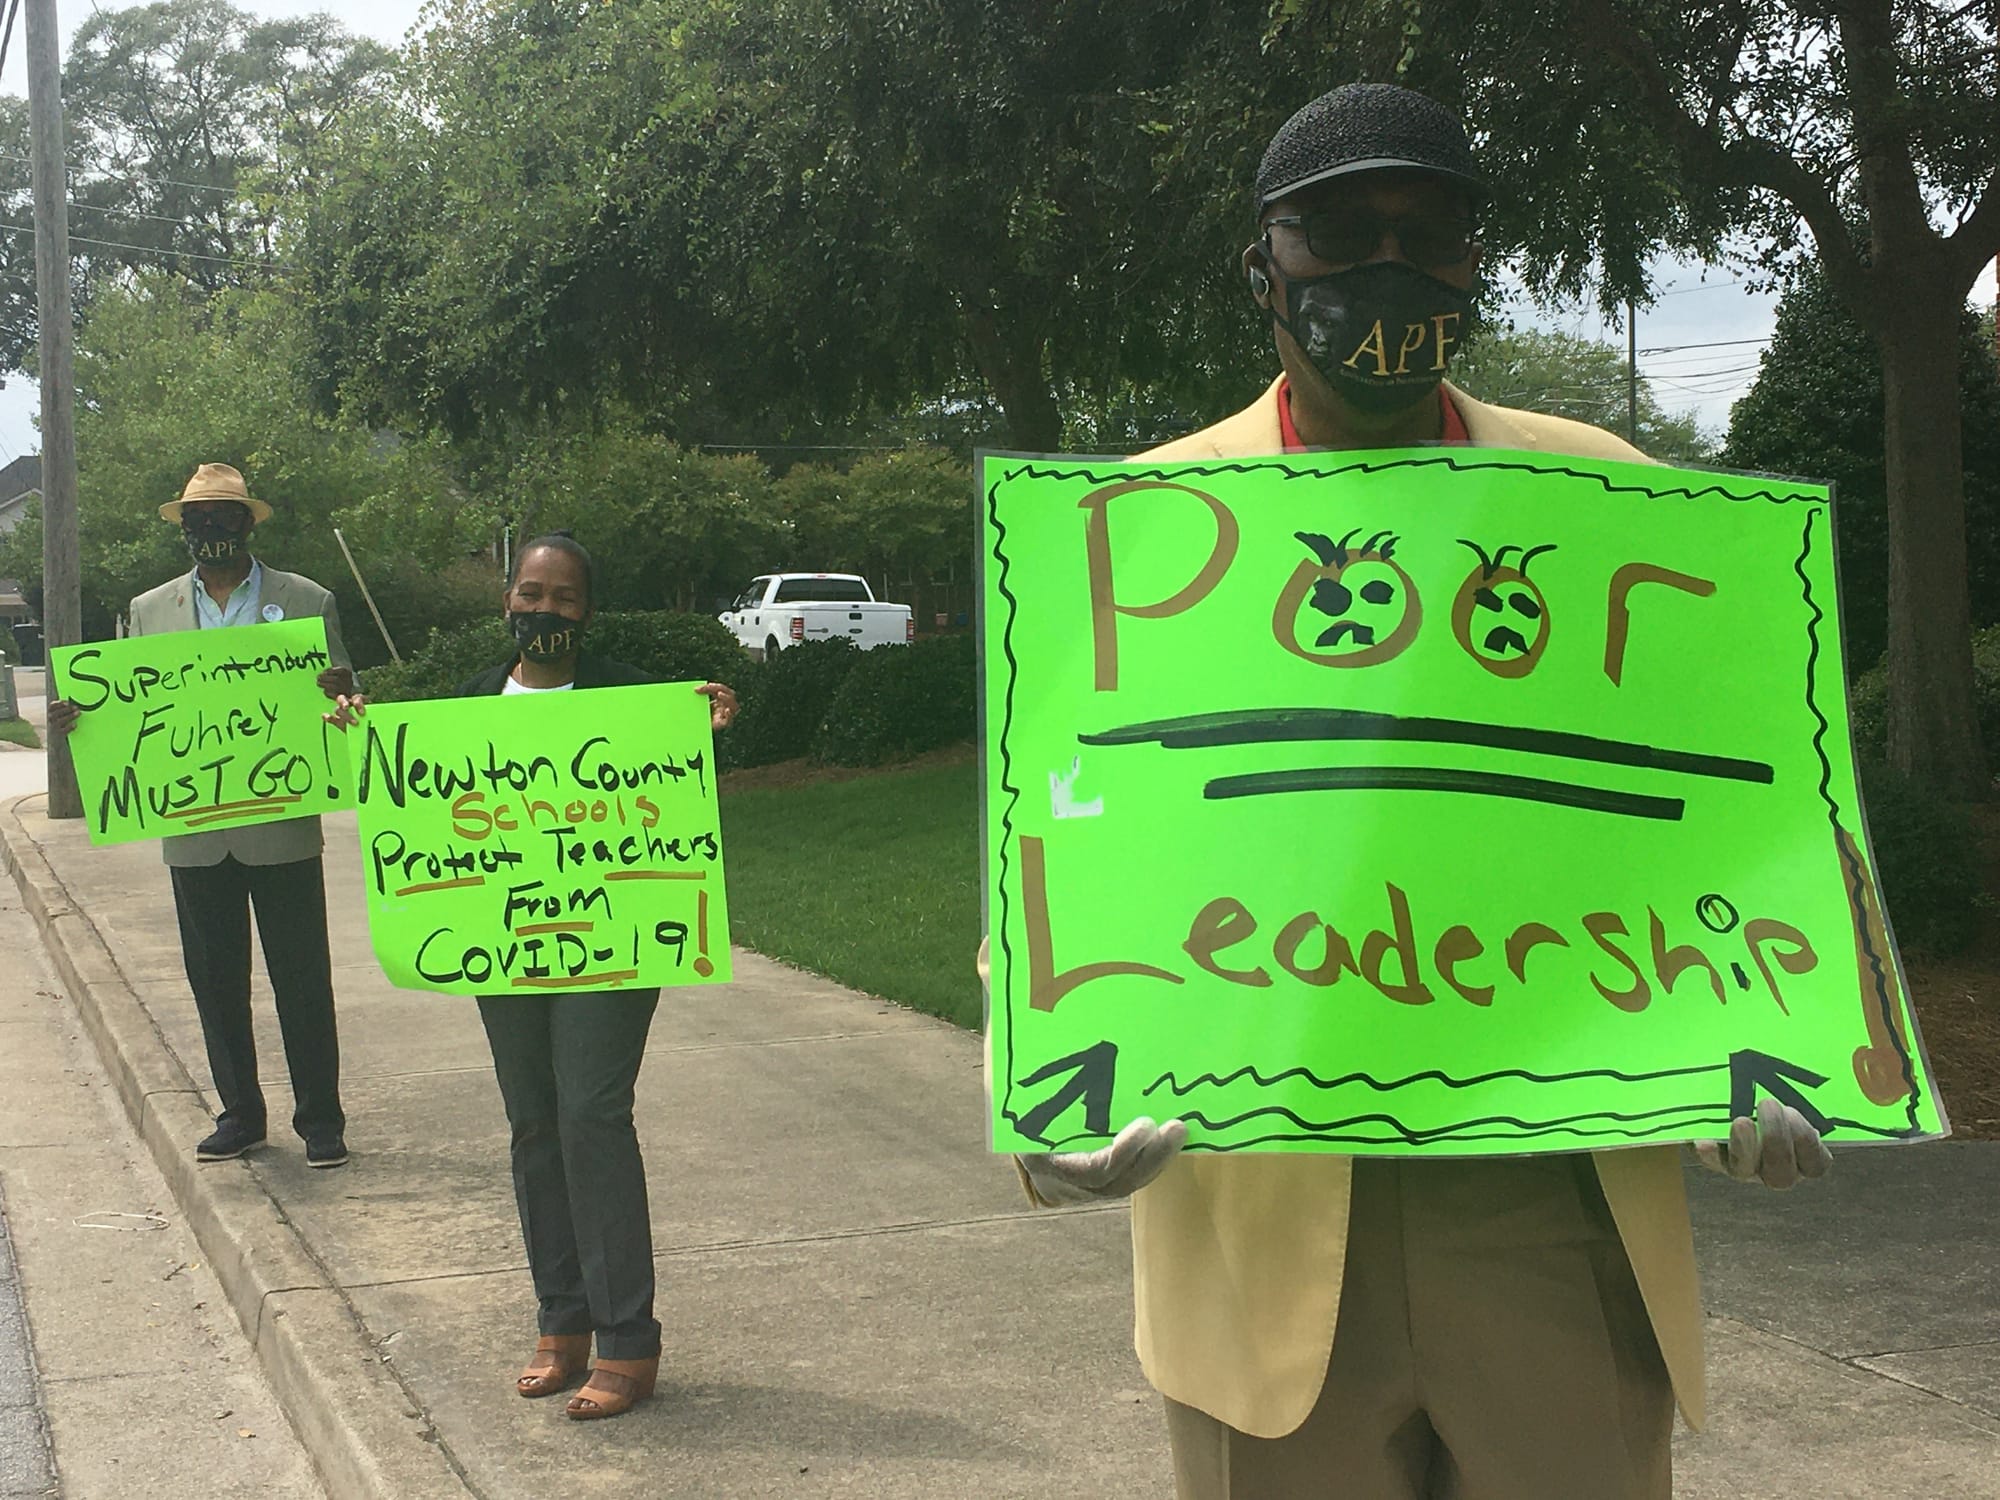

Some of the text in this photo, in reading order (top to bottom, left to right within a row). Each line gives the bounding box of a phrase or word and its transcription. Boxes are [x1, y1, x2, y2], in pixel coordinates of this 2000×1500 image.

[1342, 312, 1460, 377] APF
[1076, 480, 1717, 692] Poor
[357, 720, 706, 808] Newton County
[451, 791, 661, 841] Schools
[371, 825, 719, 896] Protect Teachers
[503, 880, 613, 932] From
